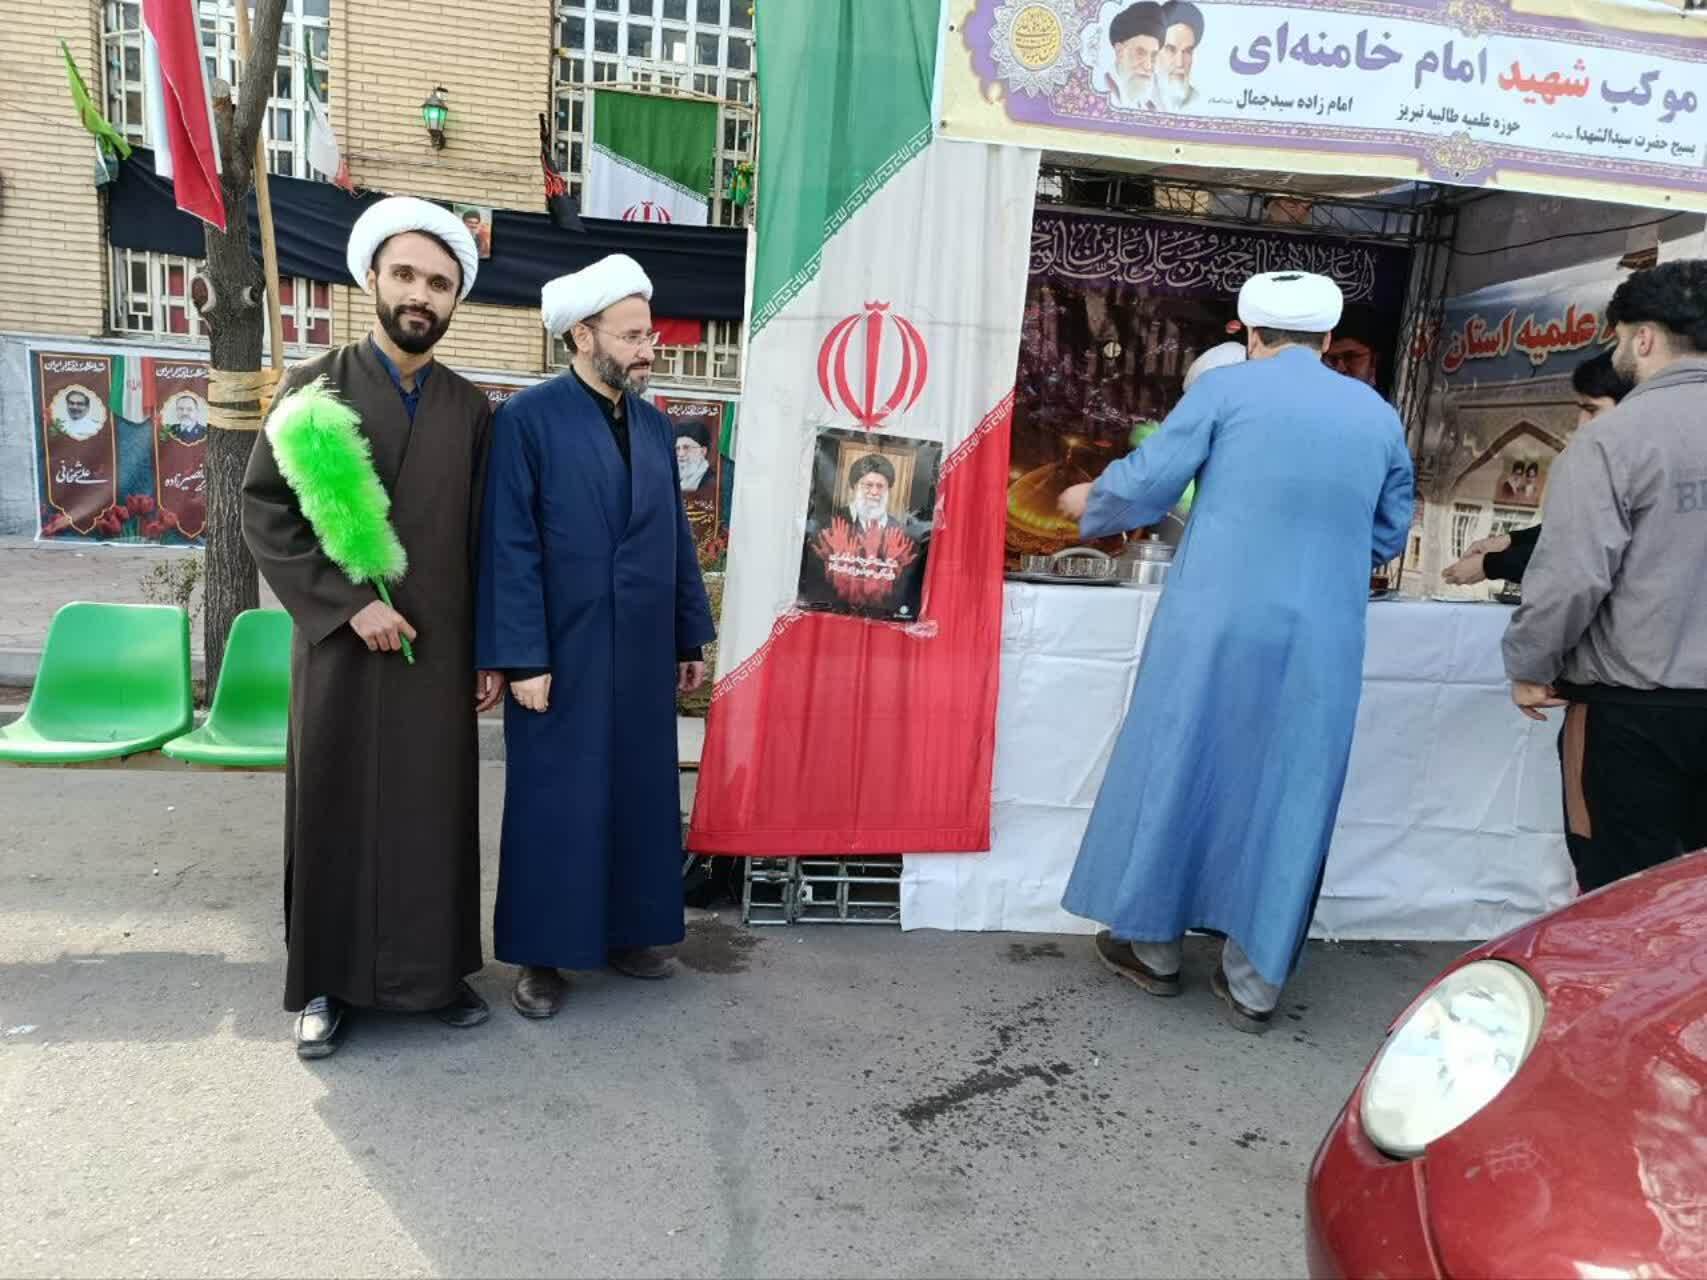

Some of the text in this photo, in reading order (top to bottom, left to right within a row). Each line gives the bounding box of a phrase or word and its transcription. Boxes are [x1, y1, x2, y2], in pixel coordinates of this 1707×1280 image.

[1414, 39, 1488, 90] امام
[1497, 57, 1590, 105] شهید
[1327, 95, 1354, 116] امام
[1395, 102, 1425, 123] تبریز
[1461, 111, 1491, 130] علمیه
[1492, 117, 1521, 136] حوزه
[1634, 132, 1668, 153] حضرت
[1442, 308, 1517, 374] استان
[1514, 303, 1599, 366] علمیه
